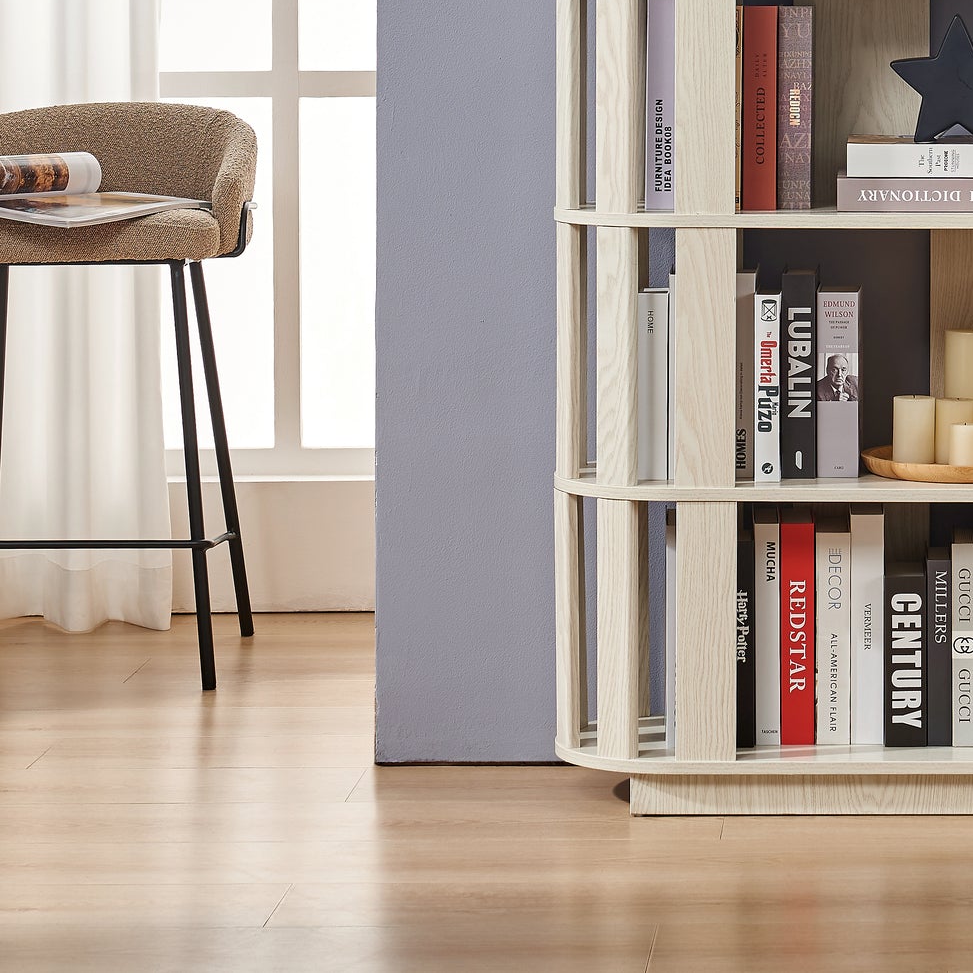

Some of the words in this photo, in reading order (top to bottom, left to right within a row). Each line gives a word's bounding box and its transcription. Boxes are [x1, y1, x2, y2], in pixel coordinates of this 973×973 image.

[655, 99, 663, 135] DESIGN
[756, 87, 766, 164] COLLECTED
[789, 88, 801, 126] REDOCN
[655, 137, 663, 192] FURNITURE
[664, 126, 672, 165] BOOK08
[664, 169, 672, 192] IDEA
[858, 188, 961, 202] DICTIONARY
[760, 340, 778, 384] Omerta
[788, 307, 812, 418] LUBALIN
[758, 384, 779, 432] Puzo
[736, 429, 747, 470] HOMES
[766, 541, 776, 582] MUCHA
[737, 589, 749, 625] Harry
[935, 570, 948, 644] MILLERS
[958, 568, 971, 623] GUCCI
[737, 626, 750, 663] Potter
[789, 580, 806, 693] REDSTAR
[864, 603, 872, 651] VERMEER
[891, 593, 922, 729] CENTURY
[958, 668, 971, 724] GUCCI
